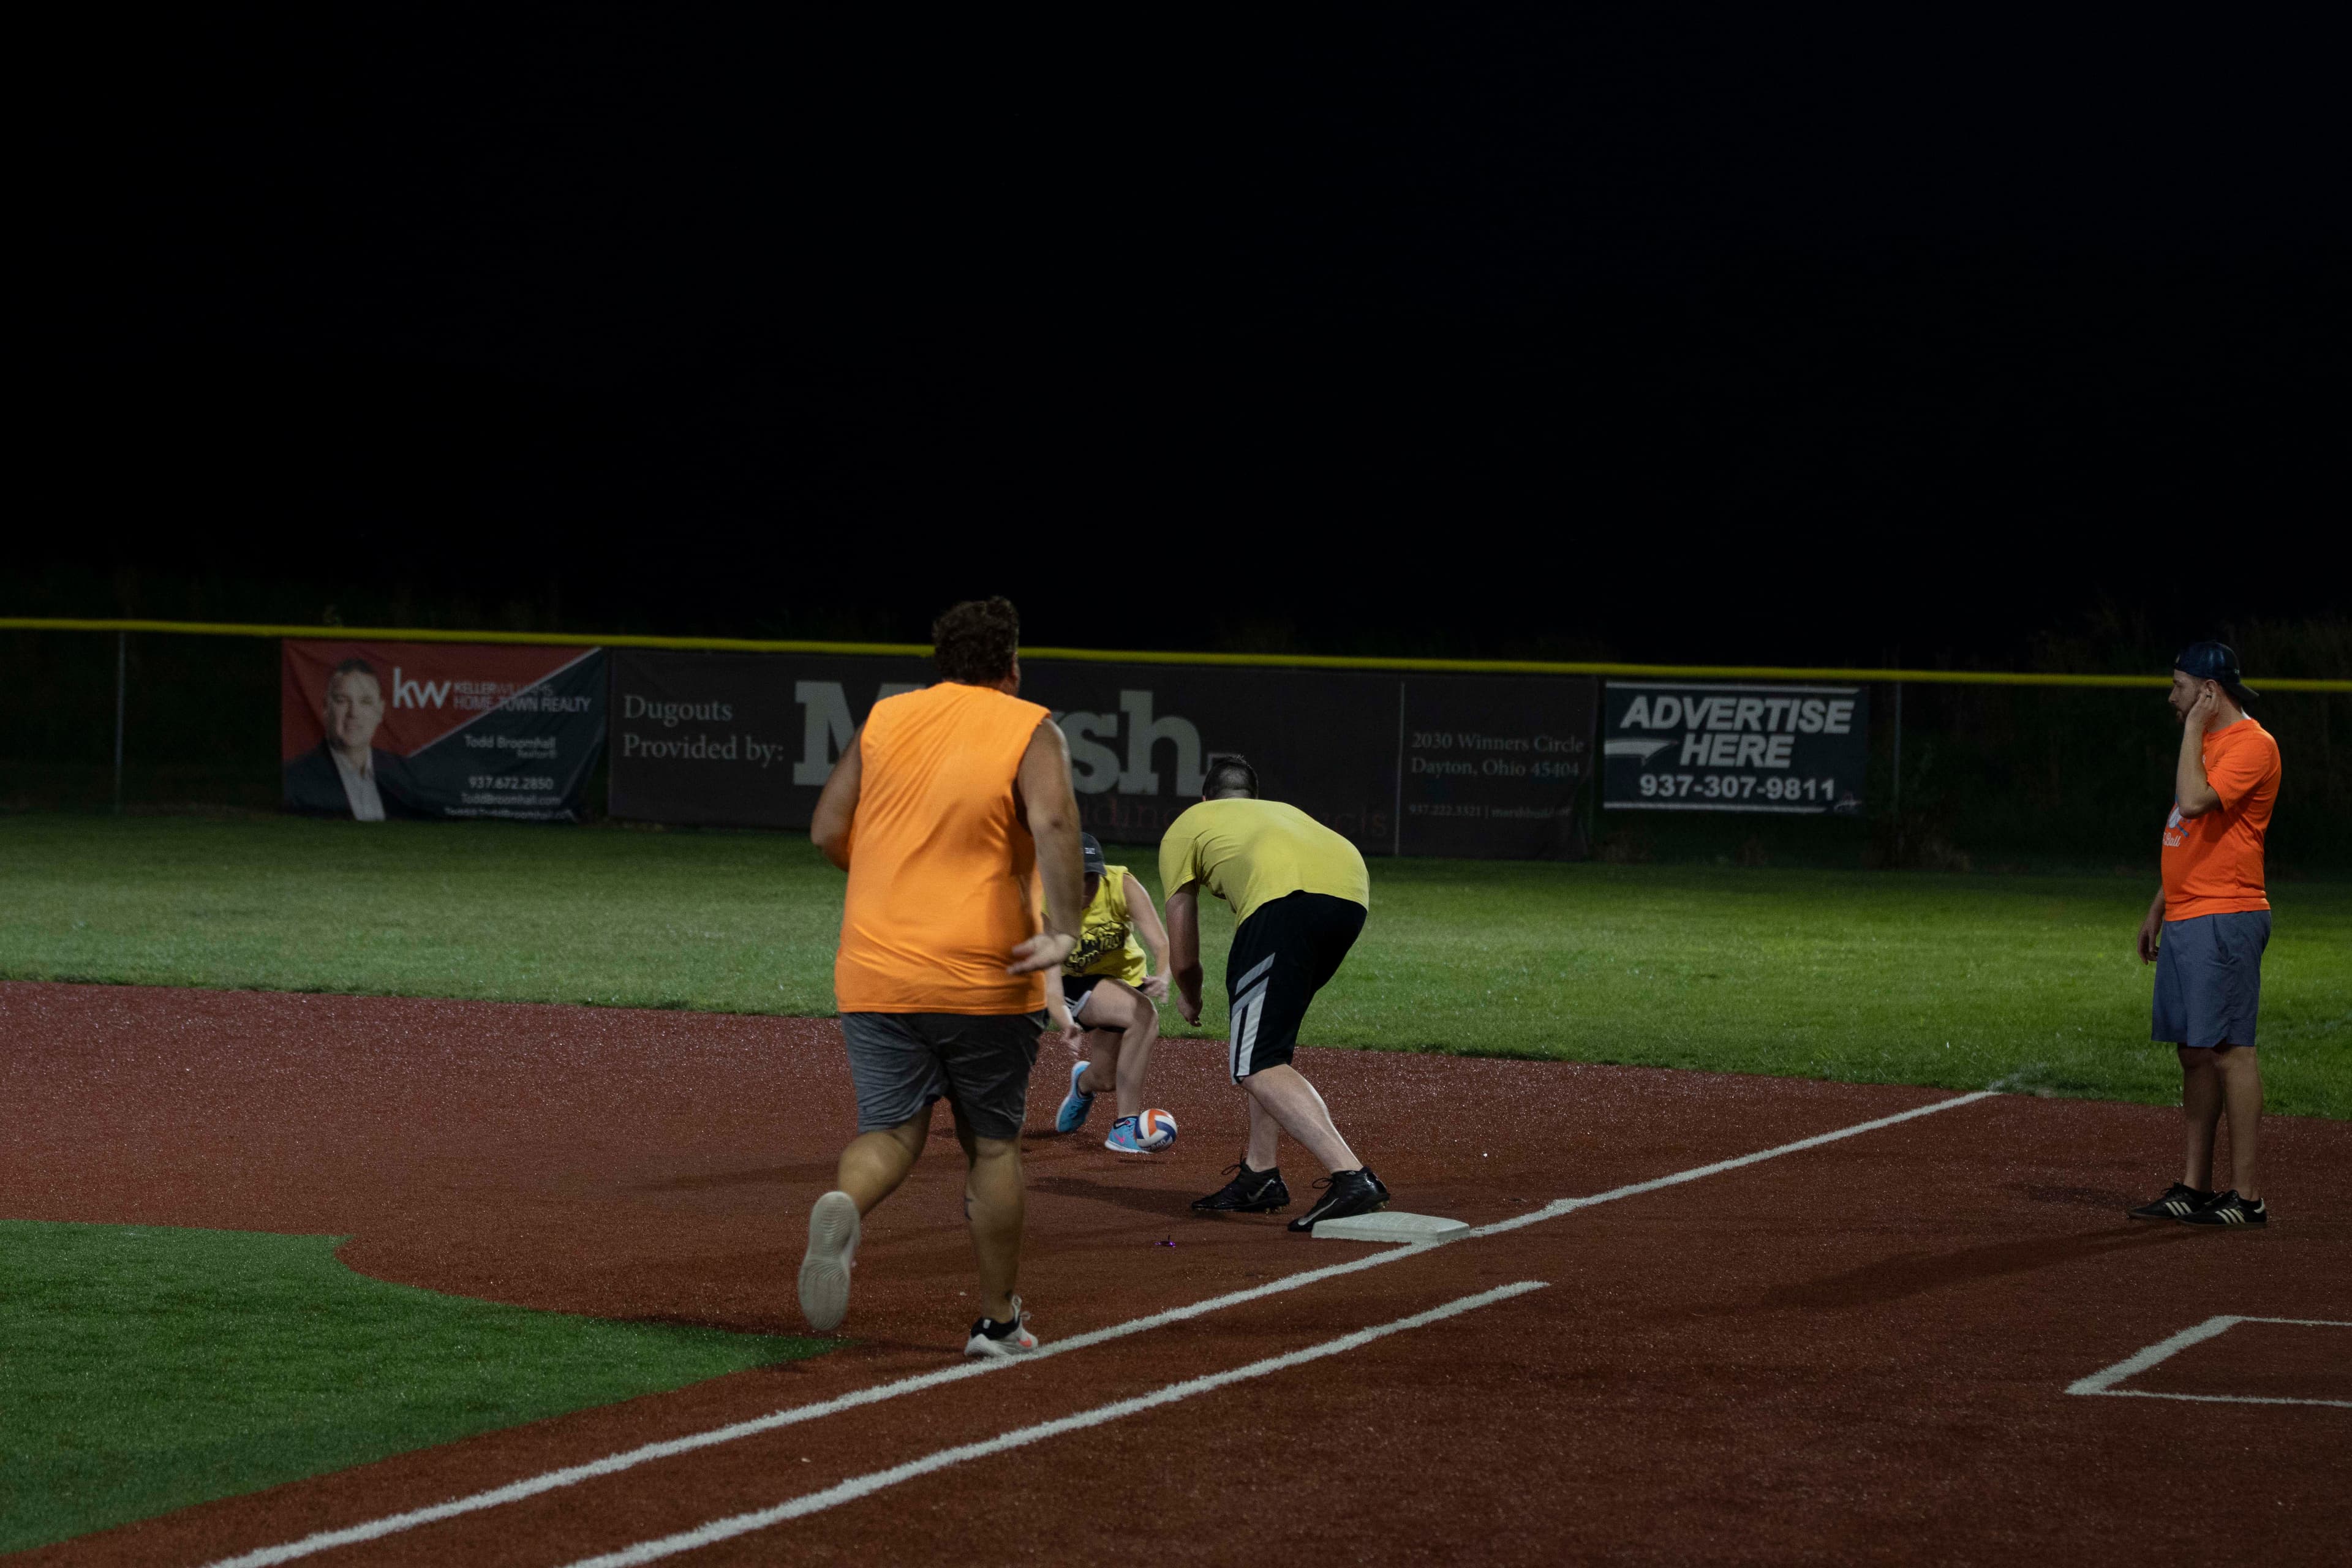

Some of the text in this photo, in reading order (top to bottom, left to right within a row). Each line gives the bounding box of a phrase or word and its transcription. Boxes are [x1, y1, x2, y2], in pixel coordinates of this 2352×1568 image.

[392, 666, 451, 709] kw
[541, 696, 592, 712] REALTY
[624, 695, 734, 728] Dugouts
[1619, 694, 1855, 734] ADVERTISE
[464, 733, 494, 748] Todd
[623, 734, 784, 768] Provided by:
[1411, 731, 1585, 753] 2030 Winners Circle
[1679, 733, 1796, 769] HERE
[1411, 756, 1580, 779] Dayton, Ohio 45404
[1639, 774, 1835, 801] 937-307-9811
